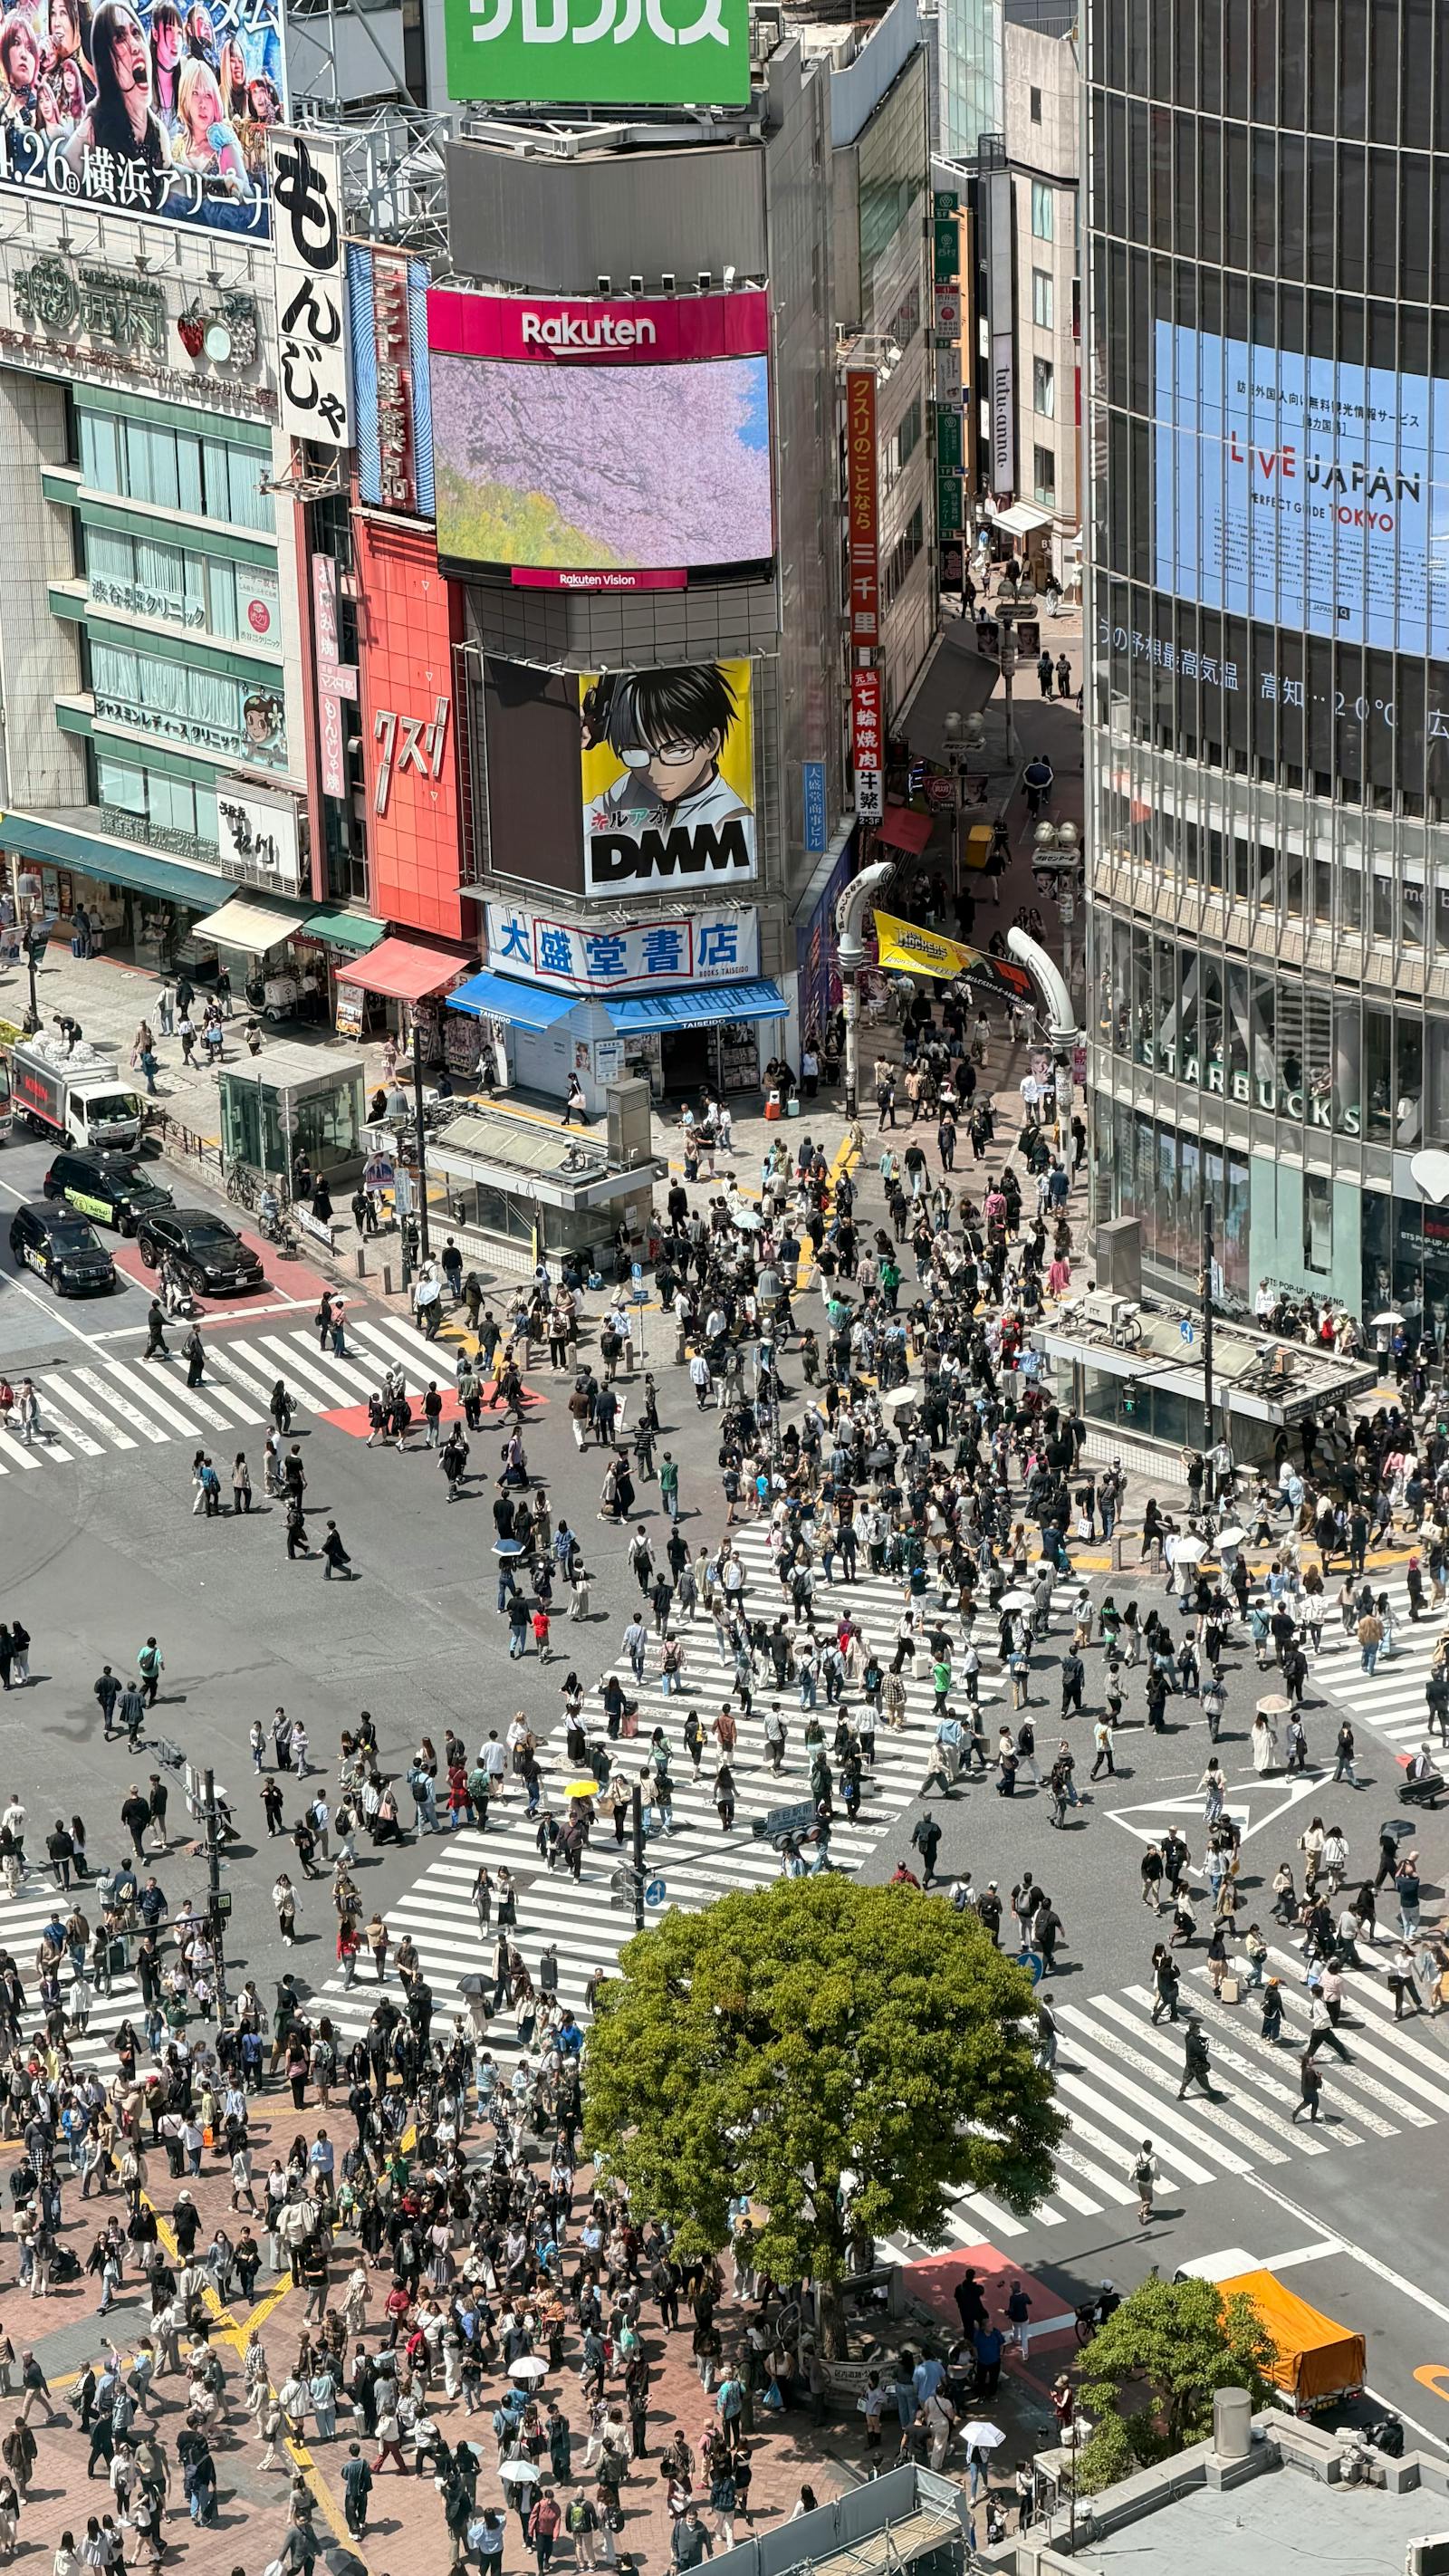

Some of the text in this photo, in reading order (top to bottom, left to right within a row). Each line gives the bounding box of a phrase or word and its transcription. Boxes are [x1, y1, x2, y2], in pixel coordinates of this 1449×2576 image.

[81, 145, 272, 229] 横浜アリーナ
[273, 138, 346, 439] もんじゃ
[522, 312, 657, 346] Rakuten
[852, 380, 871, 530] クスリのことなら
[1308, 454, 1421, 504] JAPAN
[91, 578, 205, 625] 渋谷クリニック
[559, 572, 636, 586] Rakuten Vision
[852, 543, 877, 633] 三千里
[856, 688, 878, 769] 七輪焼肉
[372, 697, 450, 816] クスリ
[859, 771, 878, 810] 牛繁
[590, 803, 669, 831] キルアオ
[590, 820, 750, 883] DMM
[1378, 877, 1425, 903] Tme
[500, 918, 739, 976] 大盛堂書店
[699, 965, 749, 977] BOOKS TAISEIDO
[479, 1010, 511, 1024] TAISEIDO
[681, 1018, 726, 1029] TAISEIDO
[1142, 1039, 1361, 1135] STARBUCKS
[1311, 1290, 1345, 1307] ARIRANG
